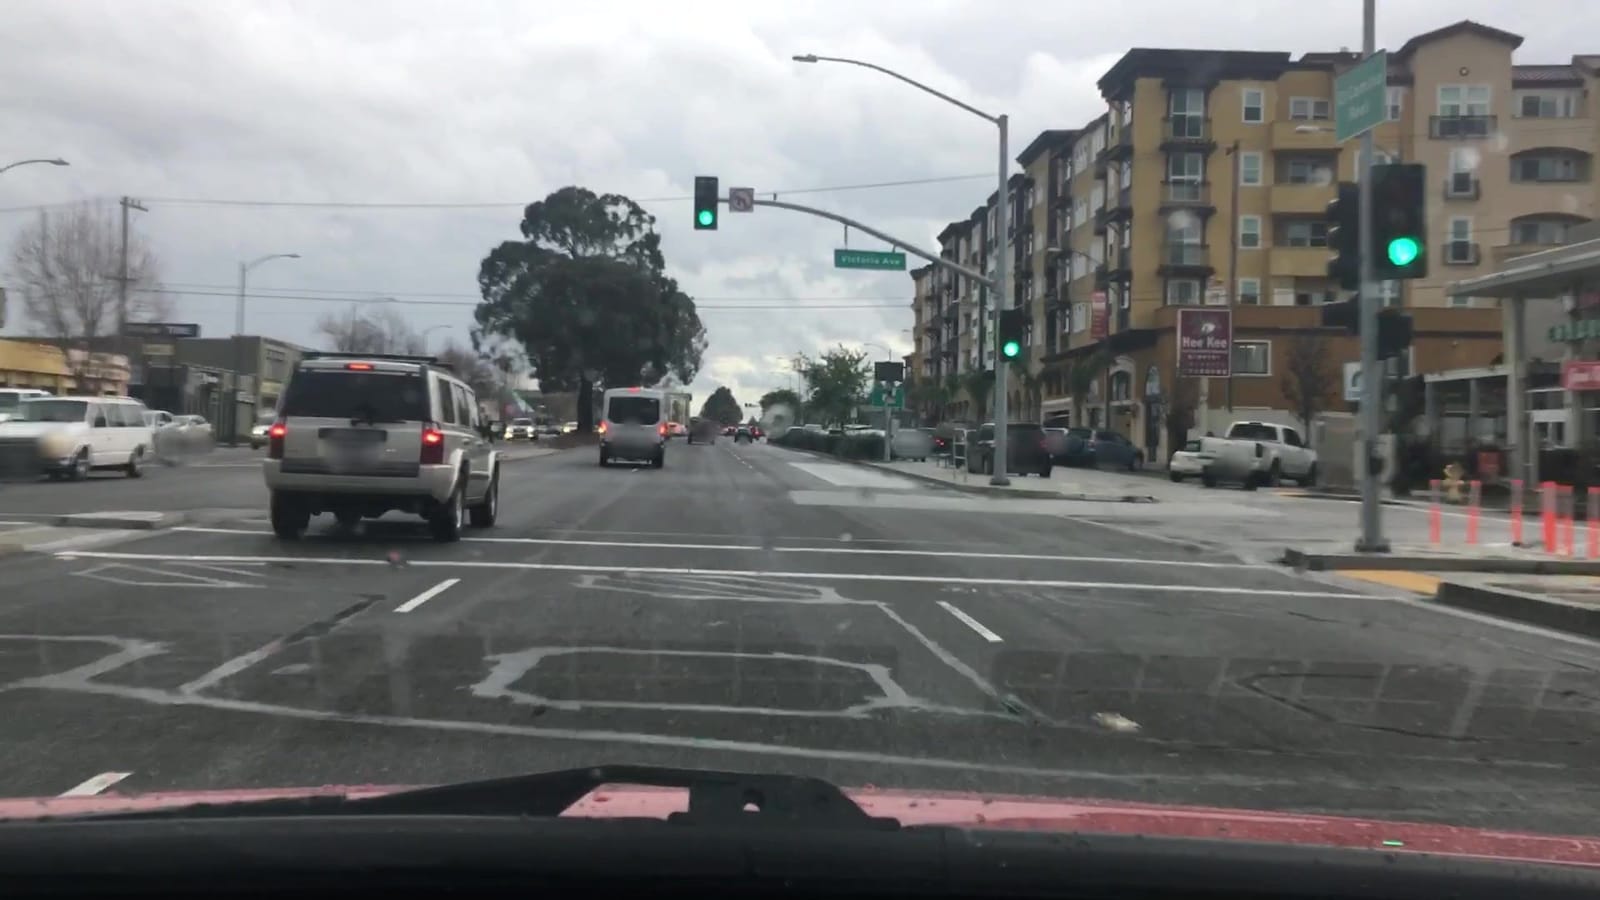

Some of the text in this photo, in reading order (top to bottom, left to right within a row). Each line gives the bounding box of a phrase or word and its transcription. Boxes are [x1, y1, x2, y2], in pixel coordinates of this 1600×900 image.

[841, 255, 901, 265] Victoria Ave
[1207, 336, 1227, 348] Kee
